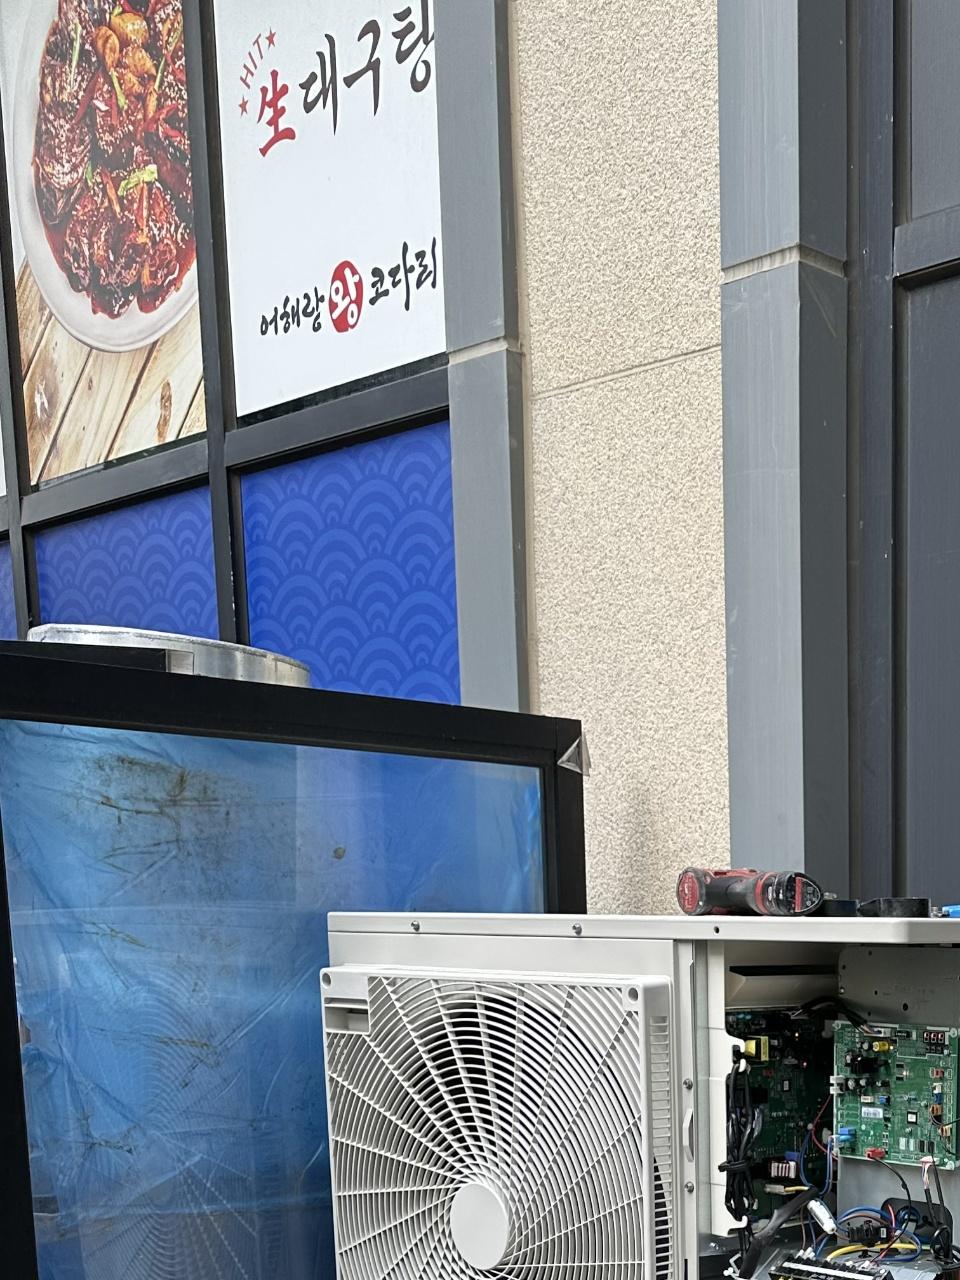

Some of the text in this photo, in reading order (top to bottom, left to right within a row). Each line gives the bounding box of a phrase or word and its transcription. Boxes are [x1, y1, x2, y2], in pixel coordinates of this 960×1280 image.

[239, 33, 264, 90] HIT
[260, 236, 437, 336] 어해랑 왕 코다리
